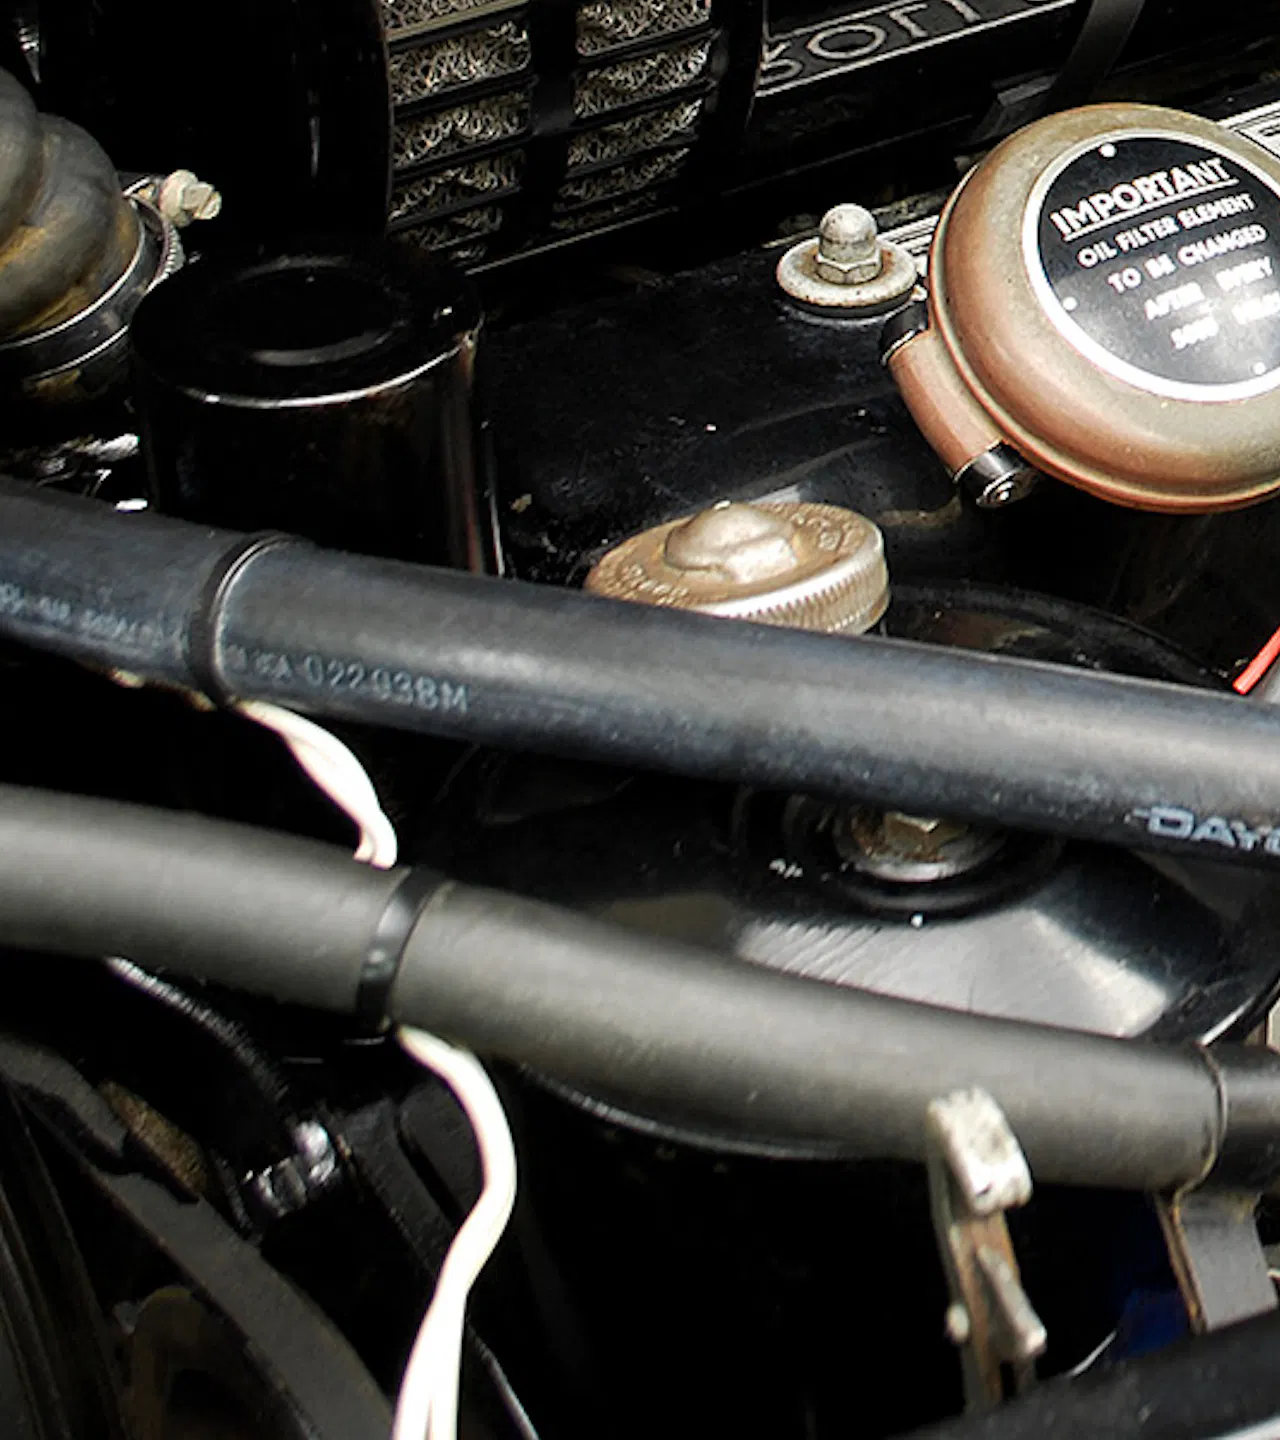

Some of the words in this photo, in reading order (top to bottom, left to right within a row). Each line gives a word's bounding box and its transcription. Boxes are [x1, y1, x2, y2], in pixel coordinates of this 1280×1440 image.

[1051, 158, 1233, 237] IMPORTANT
[1077, 242, 1118, 269] OIL
[1115, 217, 1181, 253] FILTER
[1177, 193, 1256, 231] ELEMENT
[1107, 266, 1142, 294] TO
[1178, 224, 1268, 266] CHANGED
